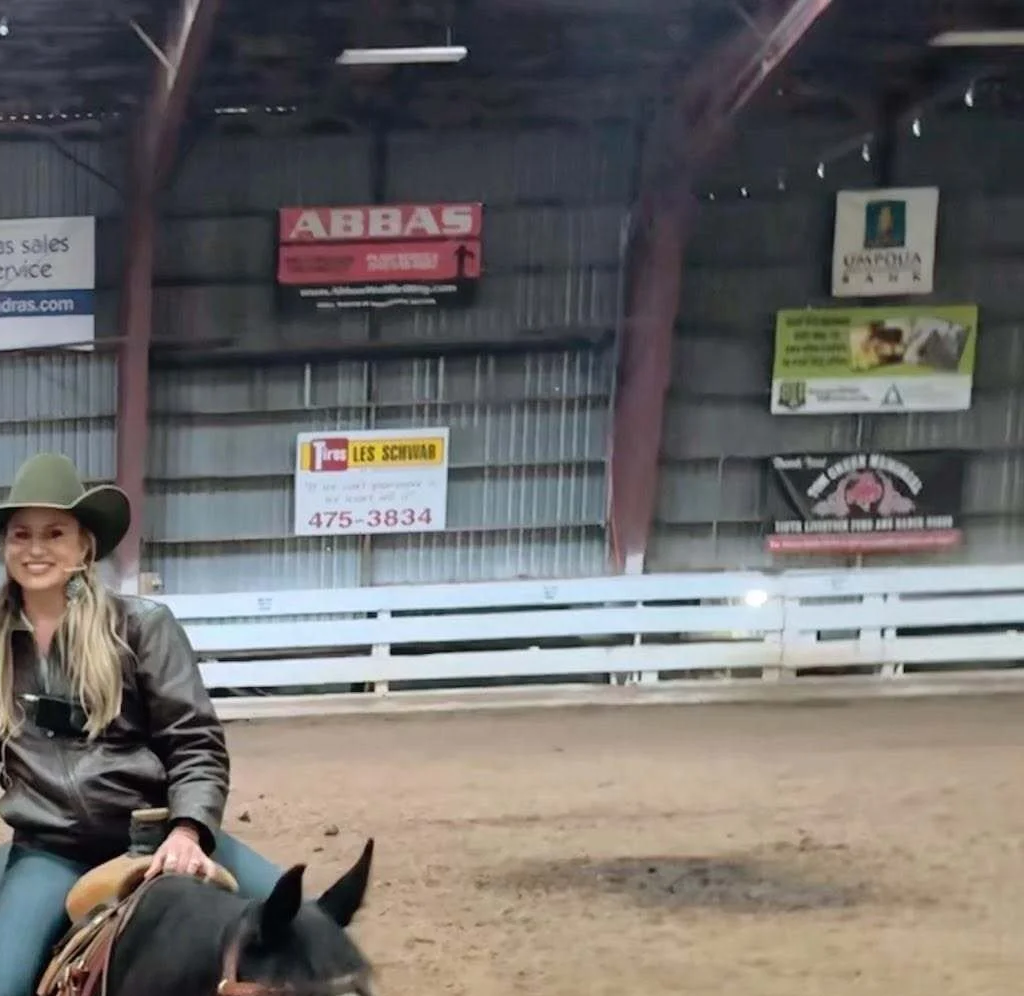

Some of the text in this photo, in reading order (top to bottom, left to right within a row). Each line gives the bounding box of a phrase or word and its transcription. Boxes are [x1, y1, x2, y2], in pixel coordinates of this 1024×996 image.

[289, 206, 473, 239] ABBAS
[22, 235, 70, 252] sales
[313, 441, 436, 470] Tires LES SCHWAB
[308, 508, 432, 529] 475-3834
